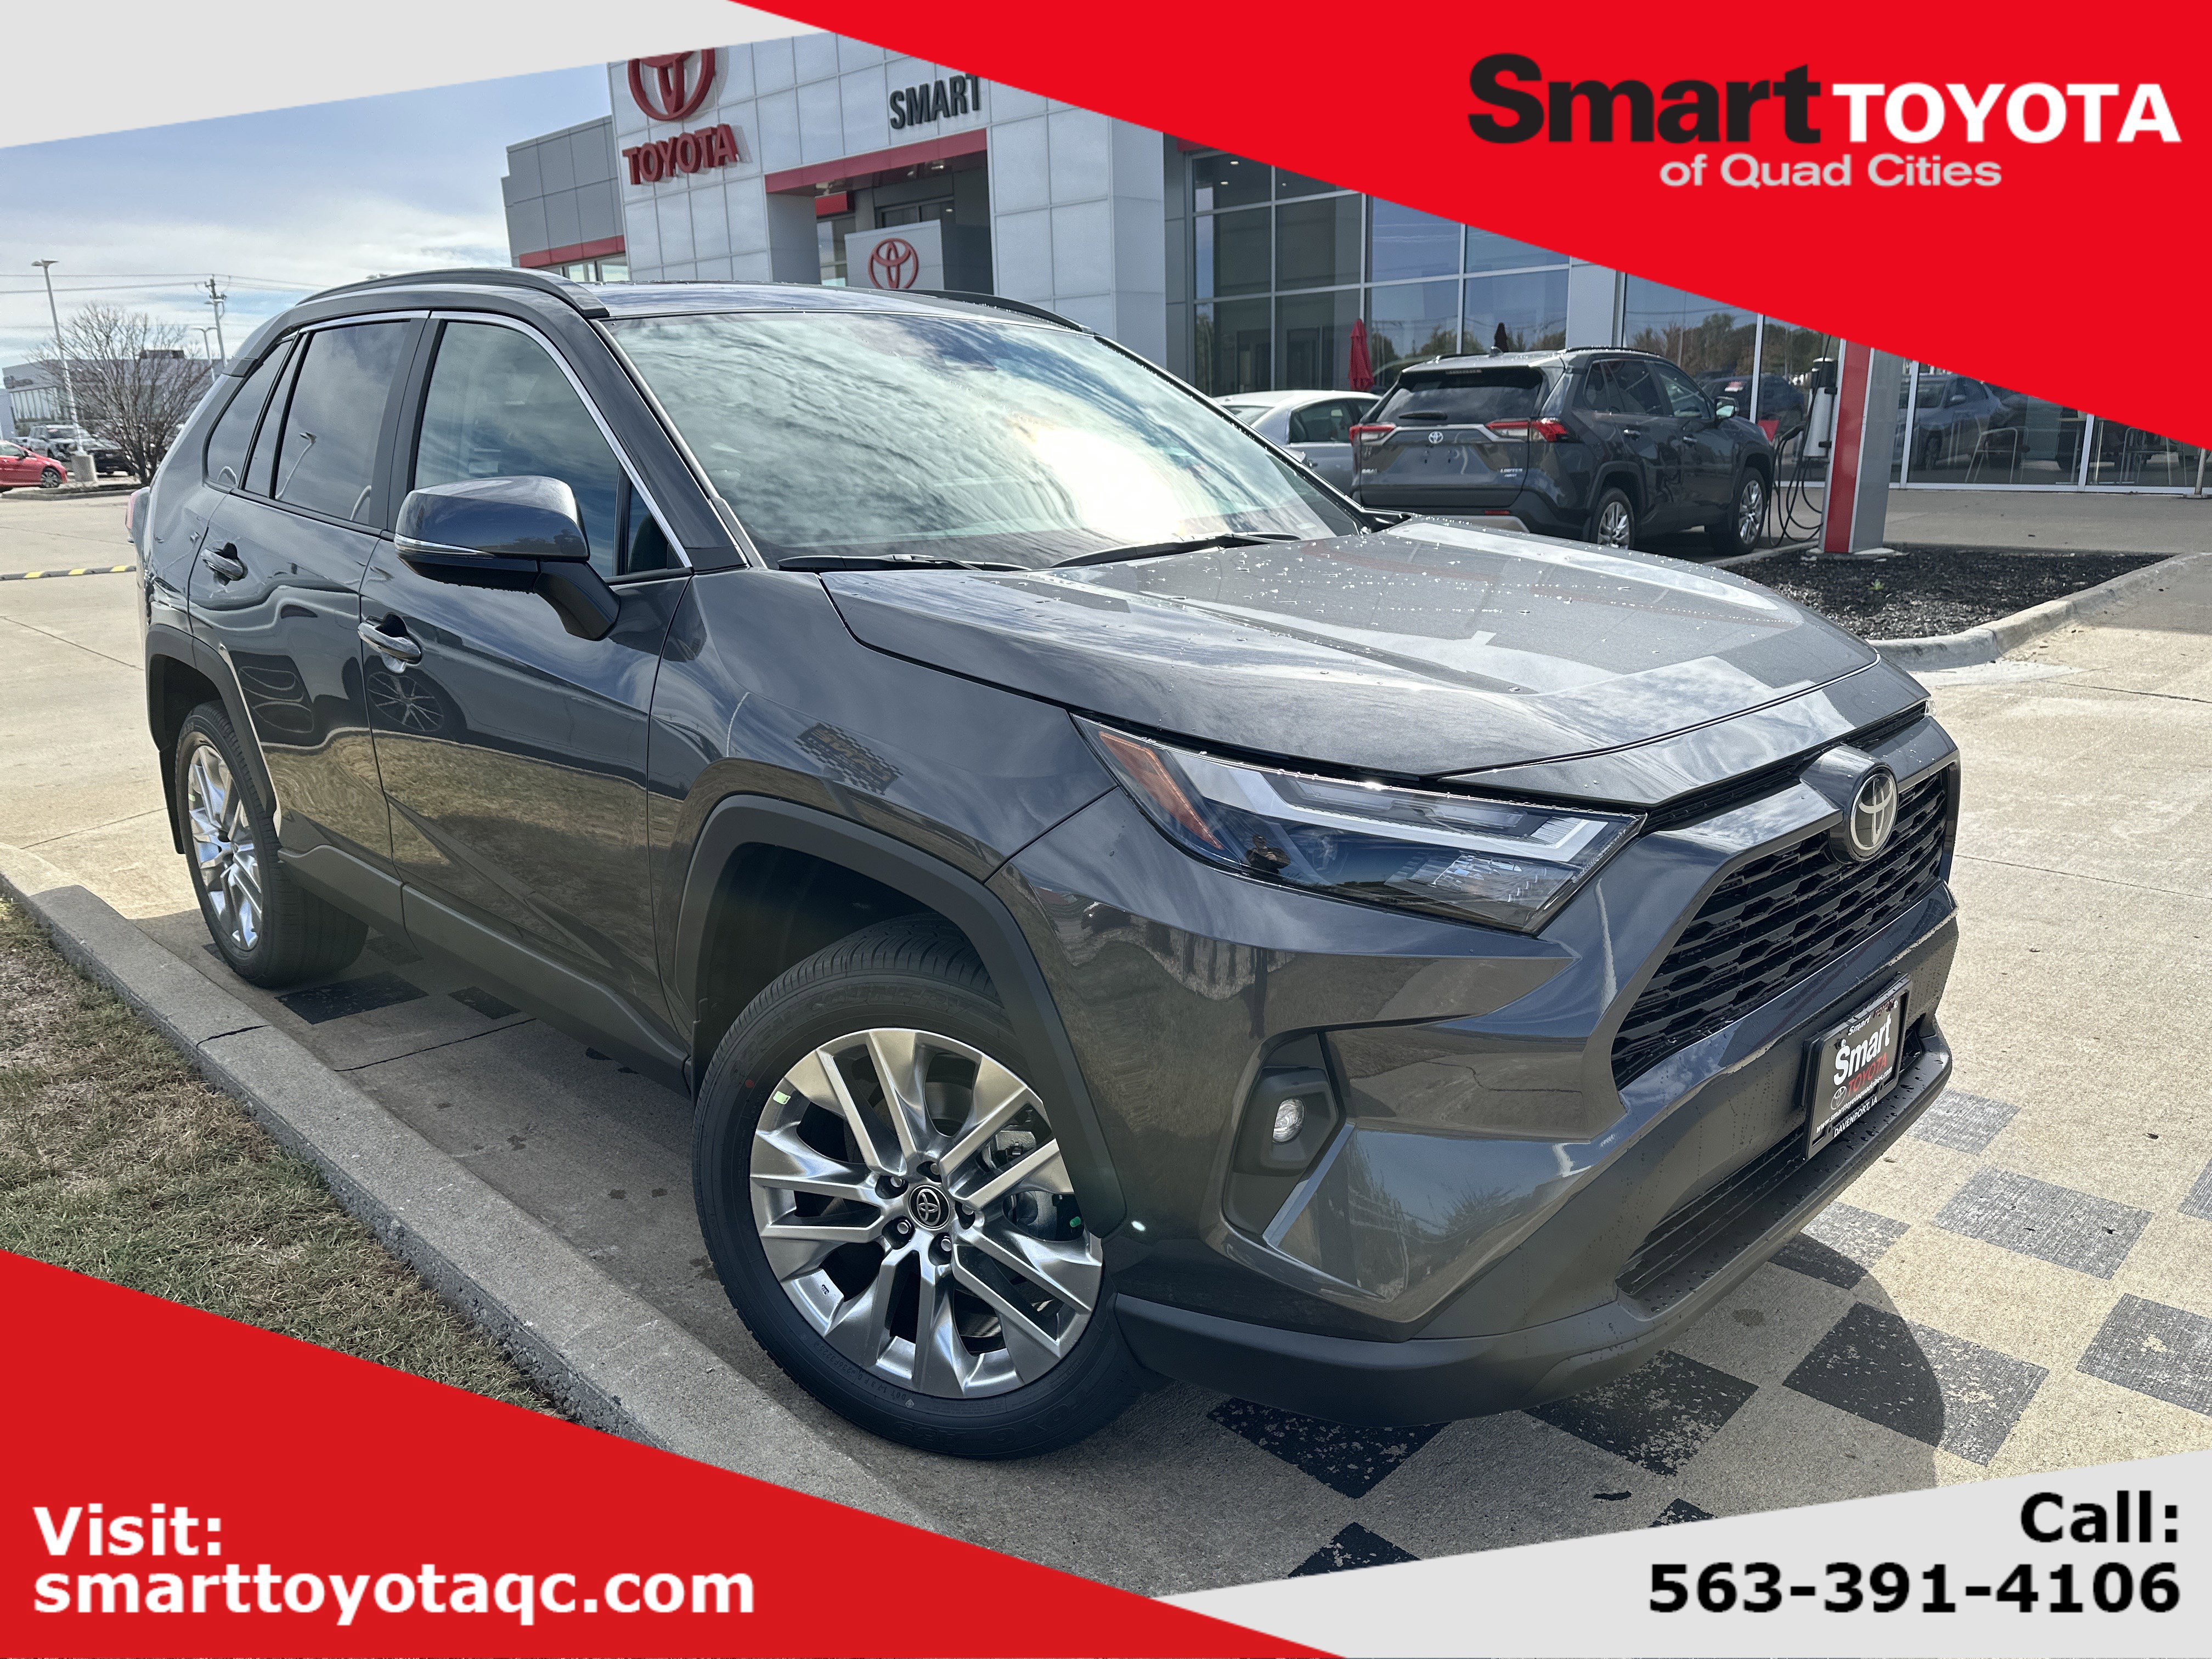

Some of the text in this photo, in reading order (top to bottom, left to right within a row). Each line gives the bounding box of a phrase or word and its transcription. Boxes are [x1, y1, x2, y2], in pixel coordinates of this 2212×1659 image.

[890, 73, 980, 129] SMART
[622, 123, 738, 185] TOYOTA
[1834, 1013, 1892, 1086] Smart
[1847, 1015, 1871, 1036] Smart
[1848, 1052, 1888, 1097] TOYOTA
[1871, 1096, 1878, 1107] IA
